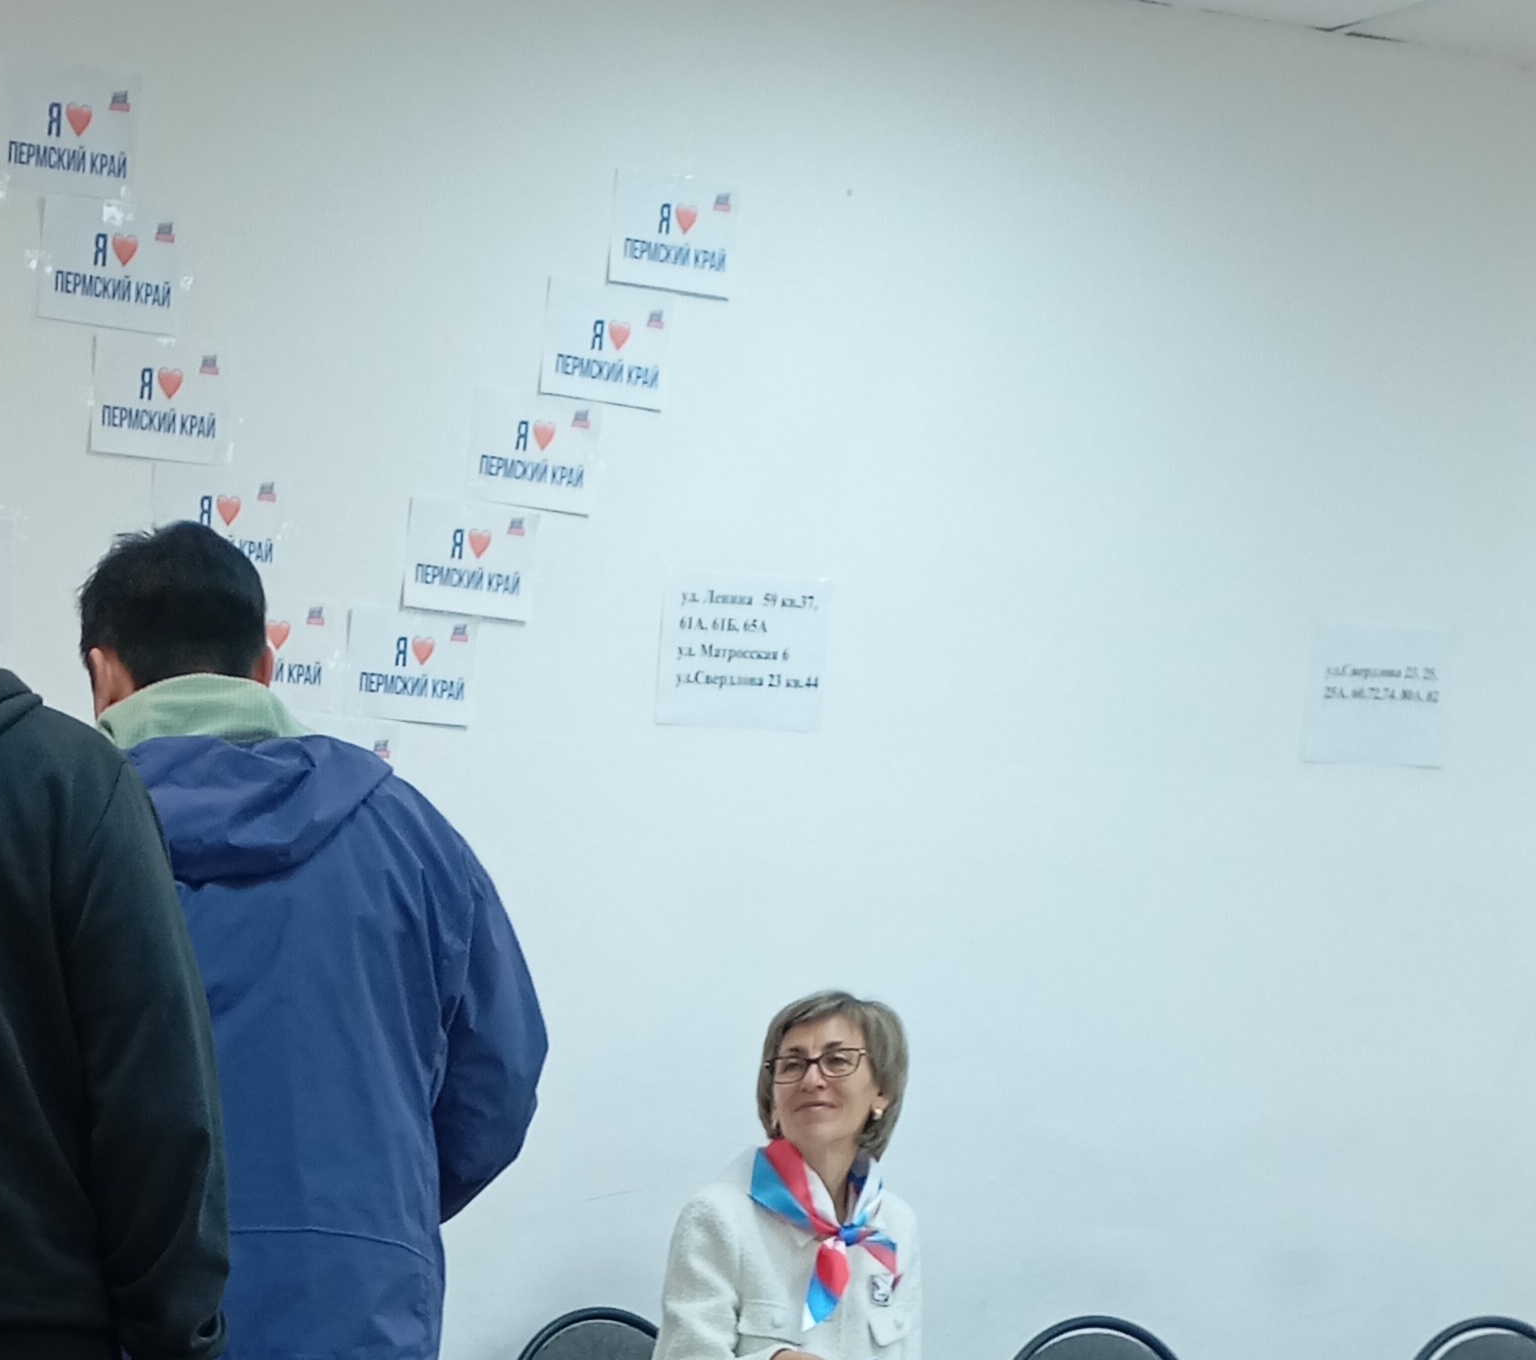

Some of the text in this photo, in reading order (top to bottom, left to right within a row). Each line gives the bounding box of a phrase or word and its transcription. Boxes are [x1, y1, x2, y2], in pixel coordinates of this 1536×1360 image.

[47, 102, 62, 138] Я
[8, 140, 128, 180] ПЕРМСКИЙ КРАЙ
[658, 203, 672, 235] Я
[94, 233, 108, 267] Я
[623, 237, 727, 273] ПЕРМСКИЙ КРАЙ
[54, 270, 172, 309] ПЕРМСКИЙ КРАЙ
[591, 319, 605, 351] Я
[139, 367, 154, 400] Я
[555, 353, 660, 389] ПЕРМСКИЙ КРАЙ
[101, 404, 217, 439] ПЕРМСКИЙ КРАЙ
[515, 420, 529, 452] Я
[479, 454, 585, 489] ПЕРМСКИЙ КРАЙ
[200, 495, 213, 527] Я
[451, 528, 465, 560] Я
[415, 563, 520, 595] ПЕРМСКИЙ КРАЙ
[703, 589, 754, 606] Ленина
[394, 636, 408, 667] Я
[700, 644, 778, 662] Матросская
[287, 661, 322, 686] КРАЙ
[359, 671, 465, 701] ПЕРМСКИЙ КРАЙ
